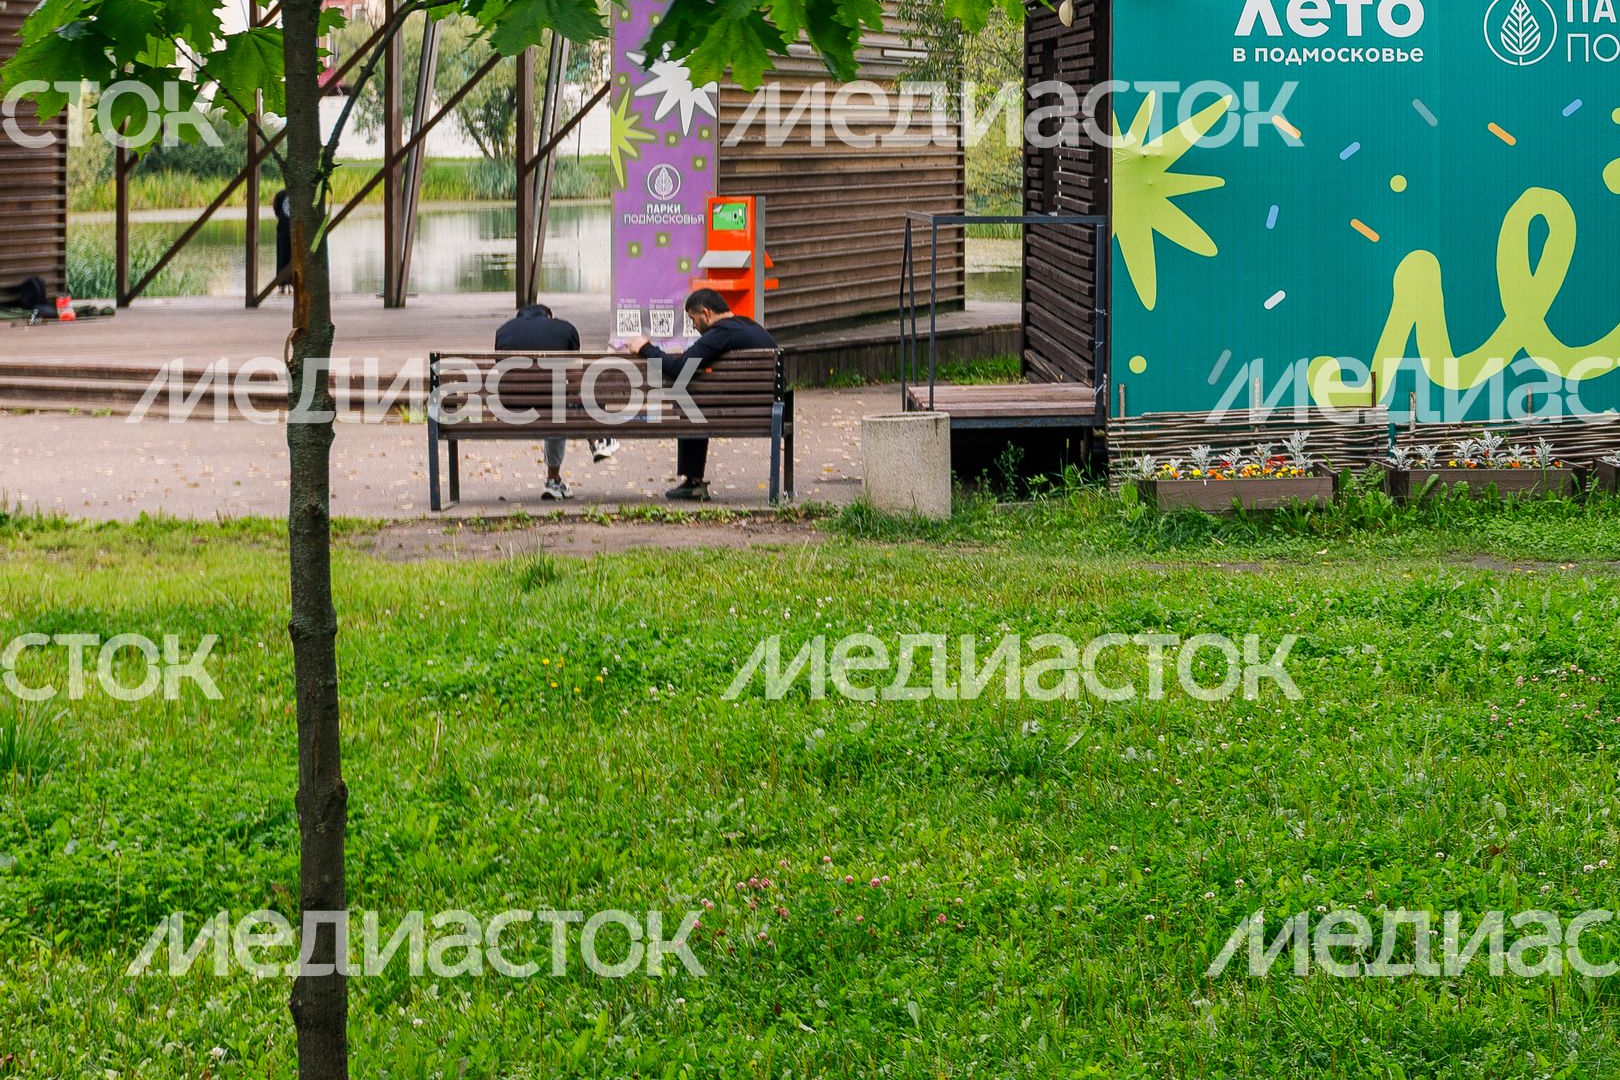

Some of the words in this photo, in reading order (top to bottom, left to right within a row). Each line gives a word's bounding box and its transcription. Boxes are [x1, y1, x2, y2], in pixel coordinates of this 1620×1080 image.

[1255, 47, 1424, 66] подмосковье
[646, 203, 681, 214] ПАРКИ
[623, 213, 705, 224] ПОДМОСКОВЬЯ
